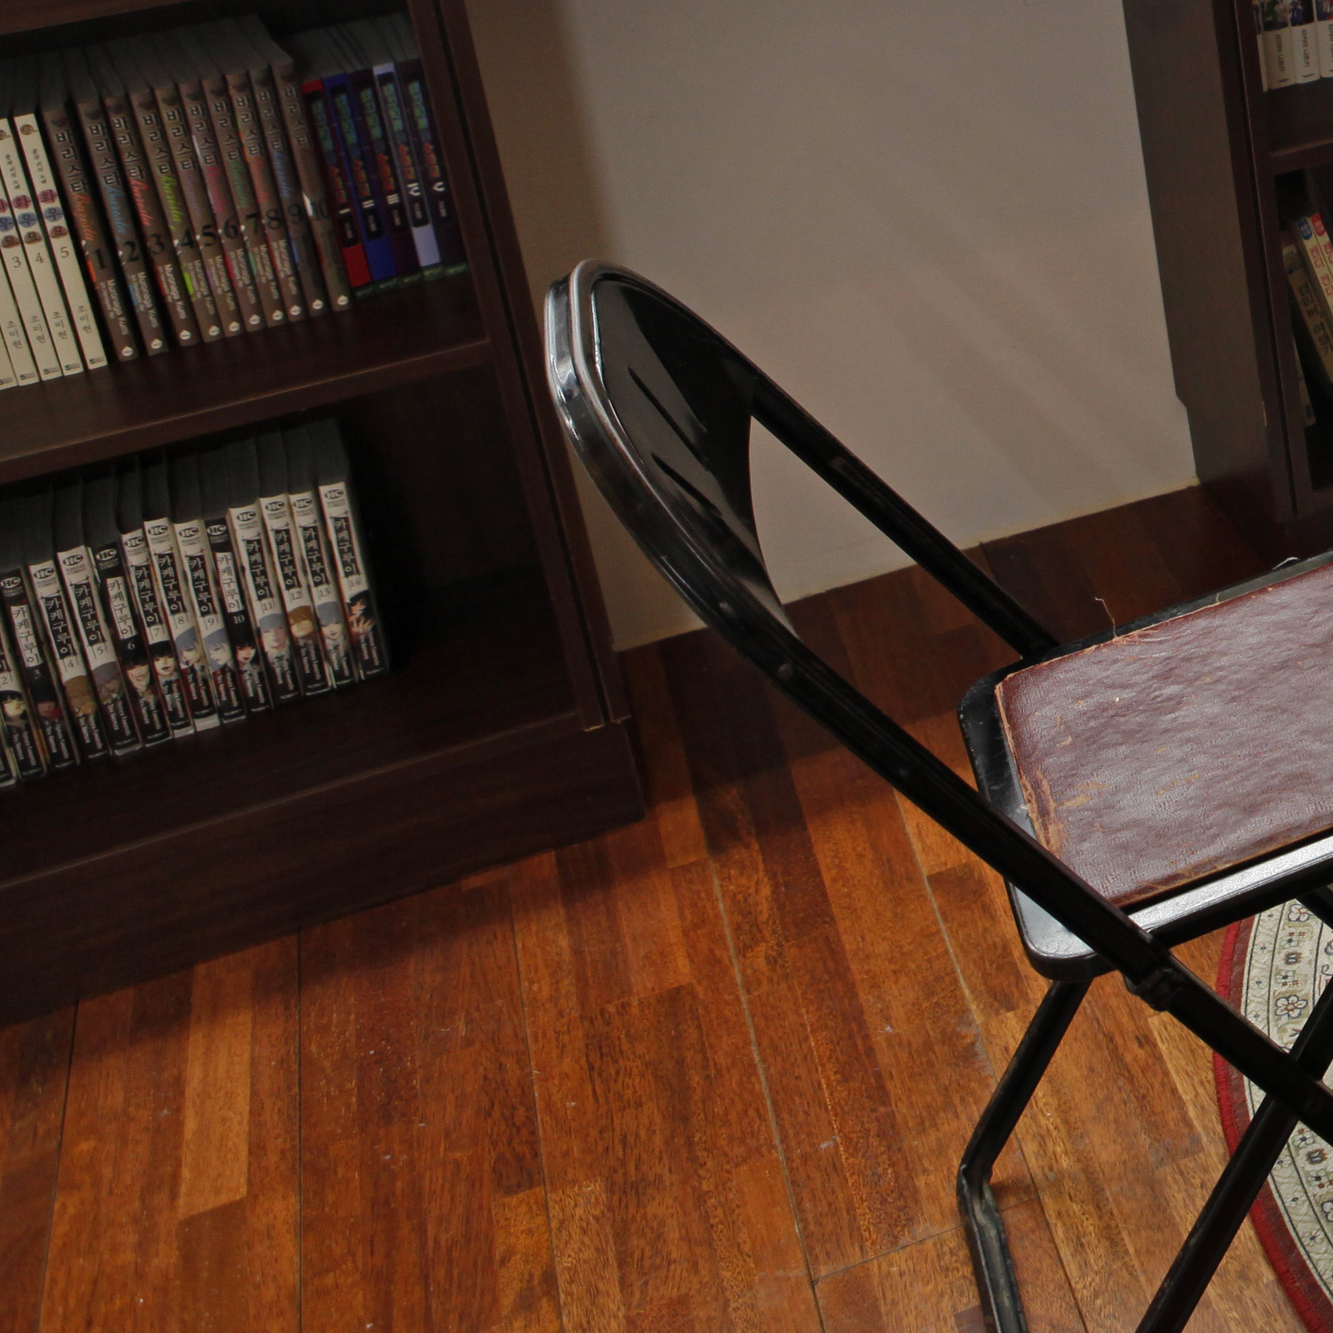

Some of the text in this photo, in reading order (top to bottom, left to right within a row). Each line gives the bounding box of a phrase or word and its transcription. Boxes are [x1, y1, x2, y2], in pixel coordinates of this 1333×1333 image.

[113, 118, 144, 179] 바리스타
[143, 114, 170, 174] 바리스타
[165, 110, 194, 170] 바리스타
[190, 105, 217, 164] 바리스타
[215, 102, 241, 160] 바리스타
[237, 97, 262, 156] 바리스타
[55, 129, 87, 193] 바리스타
[89, 123, 121, 187] 바리스타
[151, 233, 165, 255] 3
[180, 228, 194, 249] 4
[201, 224, 216, 247] 5
[223, 218, 238, 239] 6
[246, 212, 258, 234] 7
[266, 209, 282, 230] 8
[12, 256, 21, 268] 3
[35, 252, 44, 264] 4
[60, 246, 69, 258] 5
[95, 249, 107, 270] 1
[125, 241, 141, 263] 2
[106, 279, 129, 335] Muronaga Kumi
[137, 272, 158, 329] Muronaga Kumi
[164, 264, 187, 319] Muronaga Kumi
[248, 542, 271, 596] 카케구루이
[276, 530, 297, 586] 카케구루이
[303, 527, 327, 583] 카케구루이
[335, 518, 358, 573] 카케구루이
[108, 579, 134, 636] 카케구루이
[136, 567, 160, 623] 카케구루이
[160, 556, 182, 611] 카케구루이
[190, 557, 212, 612] 카케구루이
[218, 554, 241, 608] 카케구루이
[264, 601, 273, 609] 11
[292, 591, 302, 600] 12
[320, 588, 331, 596] 13
[14, 606, 42, 665] 카케구루이
[47, 596, 73, 655] 카케구루이
[76, 584, 102, 642] 카케구루이
[178, 616, 184, 624] 8
[207, 617, 214, 626] 9
[234, 615, 245, 623] 10
